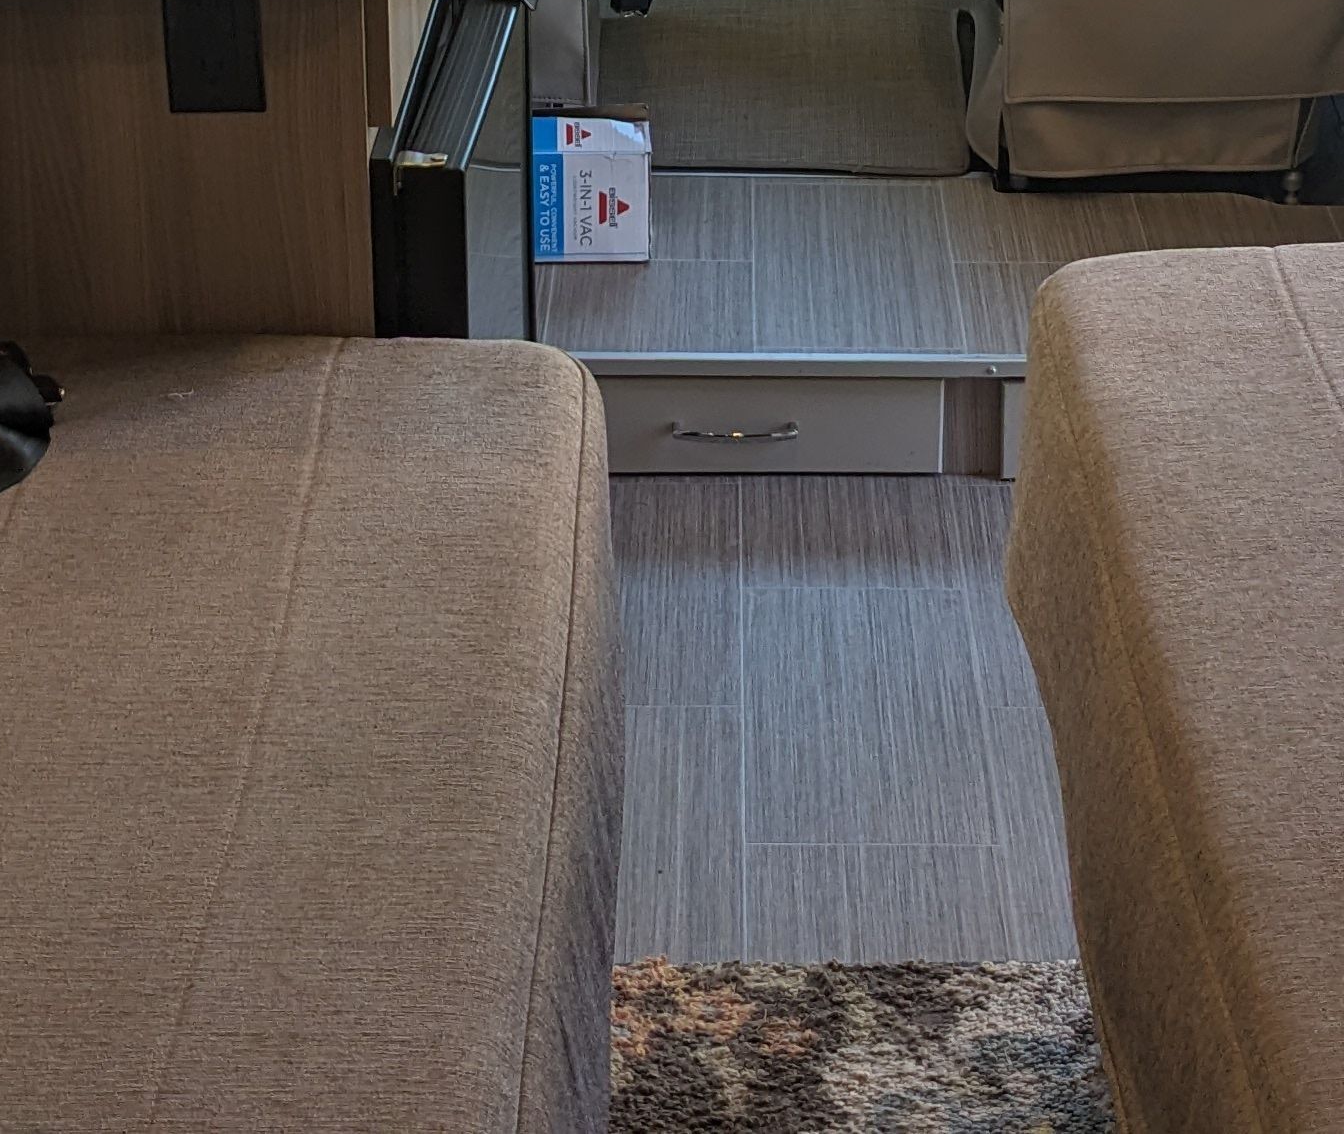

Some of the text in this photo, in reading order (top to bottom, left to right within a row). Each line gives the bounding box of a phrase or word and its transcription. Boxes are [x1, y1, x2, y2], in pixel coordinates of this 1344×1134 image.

[539, 164, 551, 252] & EASY TO USE
[579, 170, 593, 246] 3-IN-1 VAC
